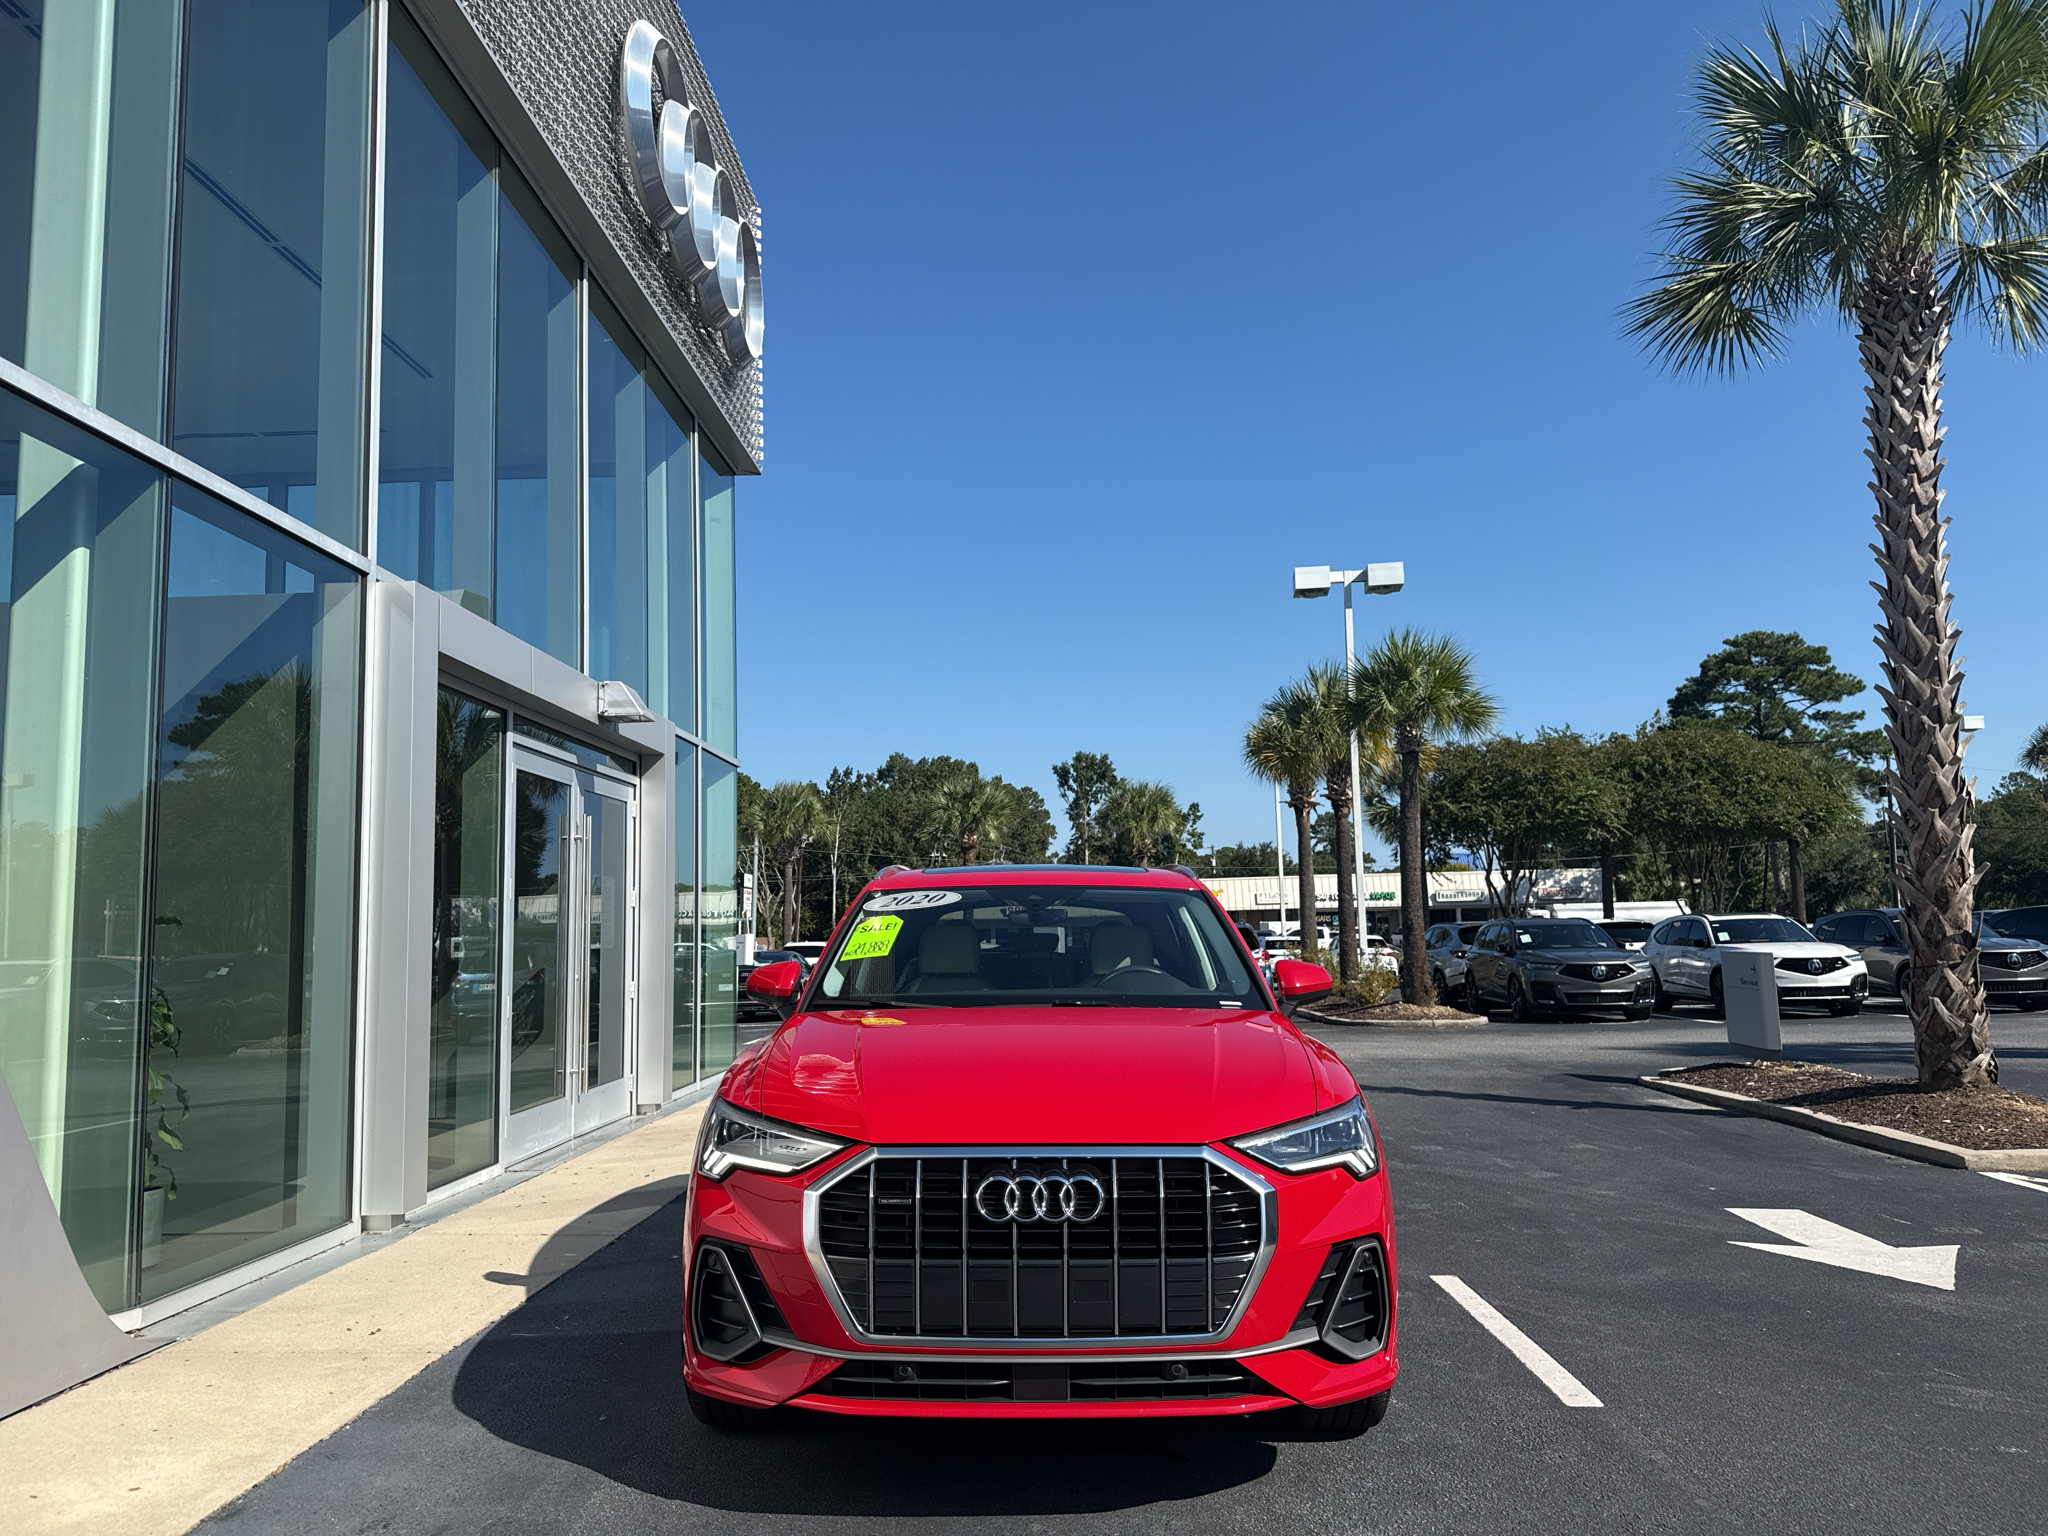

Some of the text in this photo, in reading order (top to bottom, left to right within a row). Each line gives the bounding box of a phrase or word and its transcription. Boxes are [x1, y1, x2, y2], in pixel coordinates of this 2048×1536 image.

[1371, 891, 1397, 899] VAPOR
[1441, 891, 1479, 899] BARBERSHOP
[879, 893, 947, 908] 2020
[859, 922, 898, 934] SALE!
[1740, 978, 1758, 987] Service
